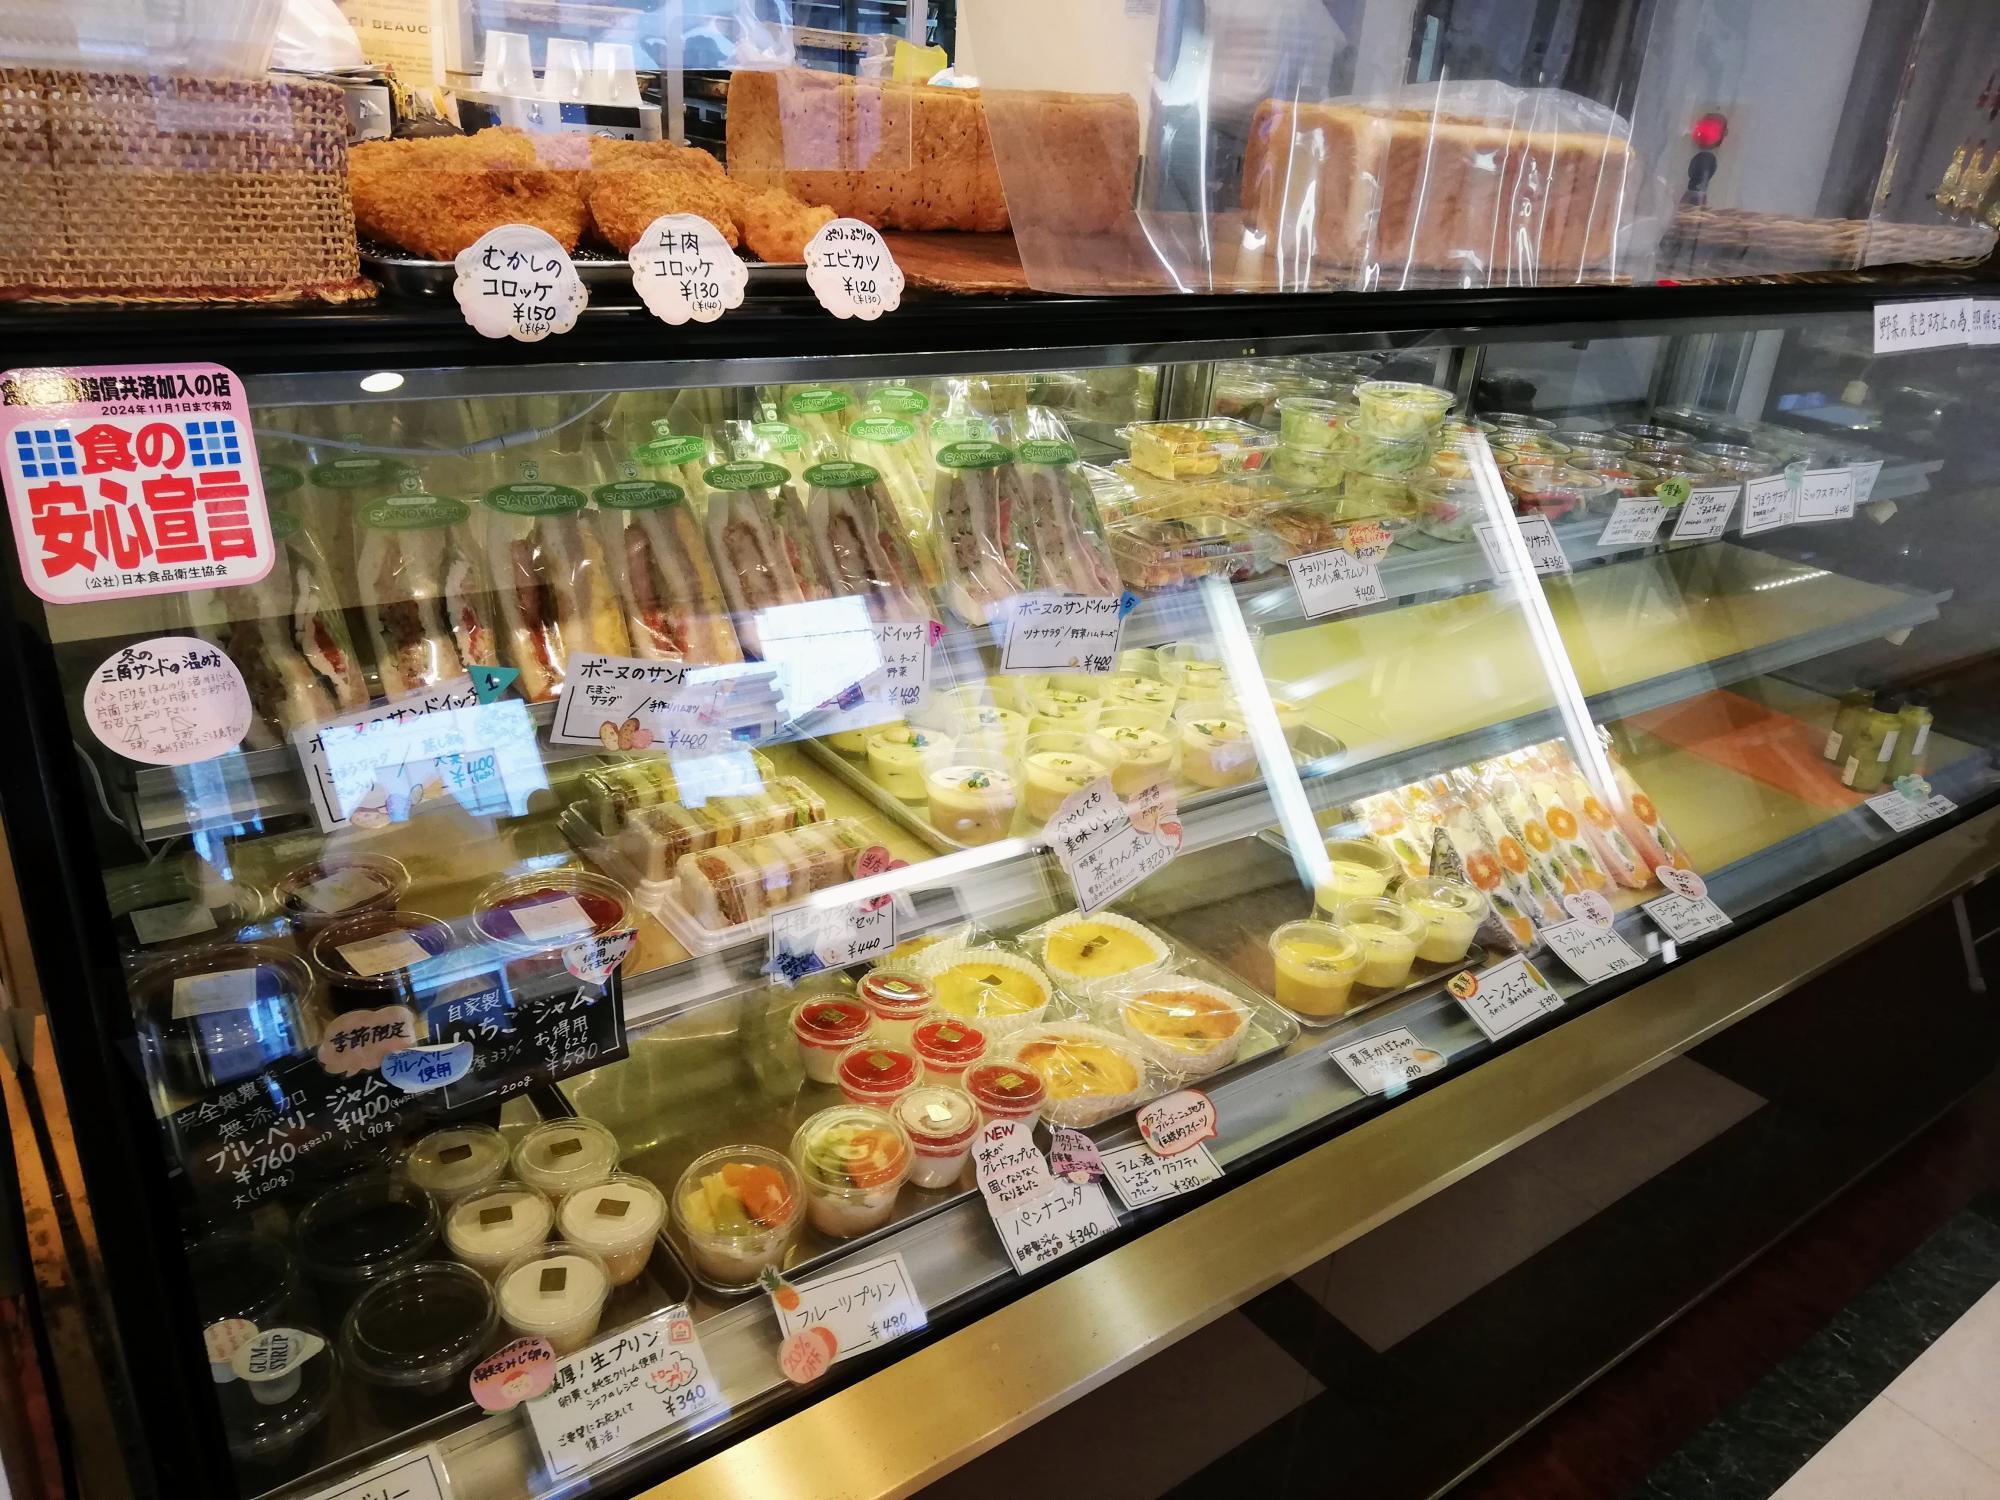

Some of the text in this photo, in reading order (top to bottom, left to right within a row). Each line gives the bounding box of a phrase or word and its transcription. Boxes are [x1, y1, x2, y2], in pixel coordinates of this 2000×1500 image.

[372, 19, 432, 34] BEAUC
[659, 230, 700, 255] 牛肉
[482, 245, 562, 278] むかしの
[654, 259, 715, 277] コロッケ
[823, 250, 880, 271] エビカツ
[482, 278, 553, 301] コロッケ
[680, 280, 719, 302] ¥130
[842, 276, 877, 295] ¥120
[512, 302, 556, 323] ¥150
[102, 401, 232, 416] 2024年11月1日まで有効
[856, 426, 911, 437] SANDWICH
[75, 422, 186, 476] 食の
[944, 451, 1008, 464] SANDWICH
[712, 470, 784, 485] SANDWICH
[812, 469, 874, 482] SANDWICH
[496, 493, 577, 508] SANDWICH
[602, 487, 677, 503] SANDWICH
[28, 470, 257, 578] 安心宣言
[85, 565, 229, 590] (公社)日本食品衛生協会
[1354, 584, 1376, 600] ¥400
[1018, 599, 1121, 616] ボーヌのサンドイッチ
[1125, 598, 1135, 609] 5
[117, 648, 153, 664] 冬の
[1084, 655, 1112, 671] ¥400
[484, 672, 500, 692] 1
[585, 684, 616, 695] たまご
[589, 694, 623, 706] サラダ
[888, 685, 920, 705] ¥400
[667, 728, 709, 748] ¥400
[449, 754, 495, 787] ¥400
[1553, 927, 1586, 945] マーブル
[1567, 930, 1617, 958] フルーツサンド
[848, 936, 881, 959] ¥440
[1477, 972, 1528, 1009] コーンスープ
[448, 988, 501, 1023] 自家製
[1537, 993, 1558, 1011] ¥390
[452, 984, 595, 1043] いちごジャム
[330, 1021, 410, 1053] 季節限定
[533, 1016, 589, 1046] お得用
[546, 1042, 598, 1079] ¥580
[417, 1062, 453, 1084] 使用
[500, 1076, 533, 1095] 200g
[176, 1073, 279, 1132] 完全無農
[333, 1094, 391, 1134] ¥400
[984, 1123, 1016, 1144] NEW
[979, 1142, 1004, 1162] 味が
[982, 1147, 1041, 1177] グレードアップして
[1115, 1152, 1155, 1173] ラム酒
[231, 1142, 297, 1185] ¥760
[988, 1165, 1040, 1195] 固くならなく
[1170, 1175, 1200, 1194] ¥380
[999, 1181, 1040, 1203] なりました
[1015, 1186, 1083, 1236] パンナコッタ
[1066, 1222, 1100, 1249] ¥340
[796, 1283, 897, 1328] フルーツプリン
[249, 1347, 269, 1374] GUM
[270, 1334, 290, 1370] SYRUP
[663, 1383, 706, 1417] ¥340
